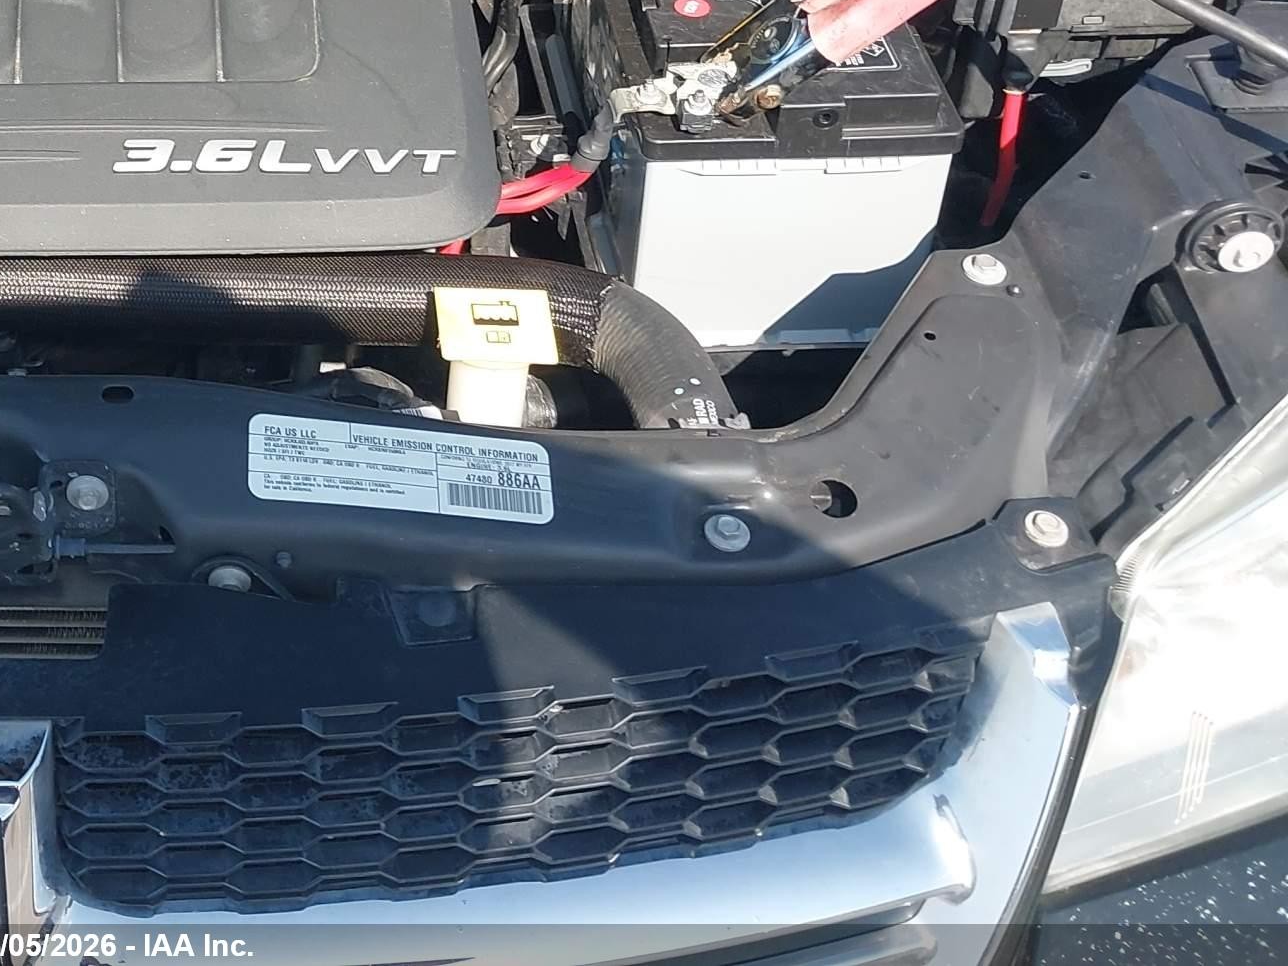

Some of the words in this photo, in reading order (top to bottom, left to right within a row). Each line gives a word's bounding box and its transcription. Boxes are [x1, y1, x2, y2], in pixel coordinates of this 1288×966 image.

[264, 425, 281, 436] FCA
[284, 427, 297, 437] US
[300, 429, 317, 439] LLC
[352, 434, 388, 447] VEHICLE
[391, 439, 433, 450] EMISSION
[436, 443, 475, 455] CONTROL
[478, 448, 539, 462] INFORMATION
[465, 474, 492, 484] 47480
[497, 472, 541, 490] 886AA
